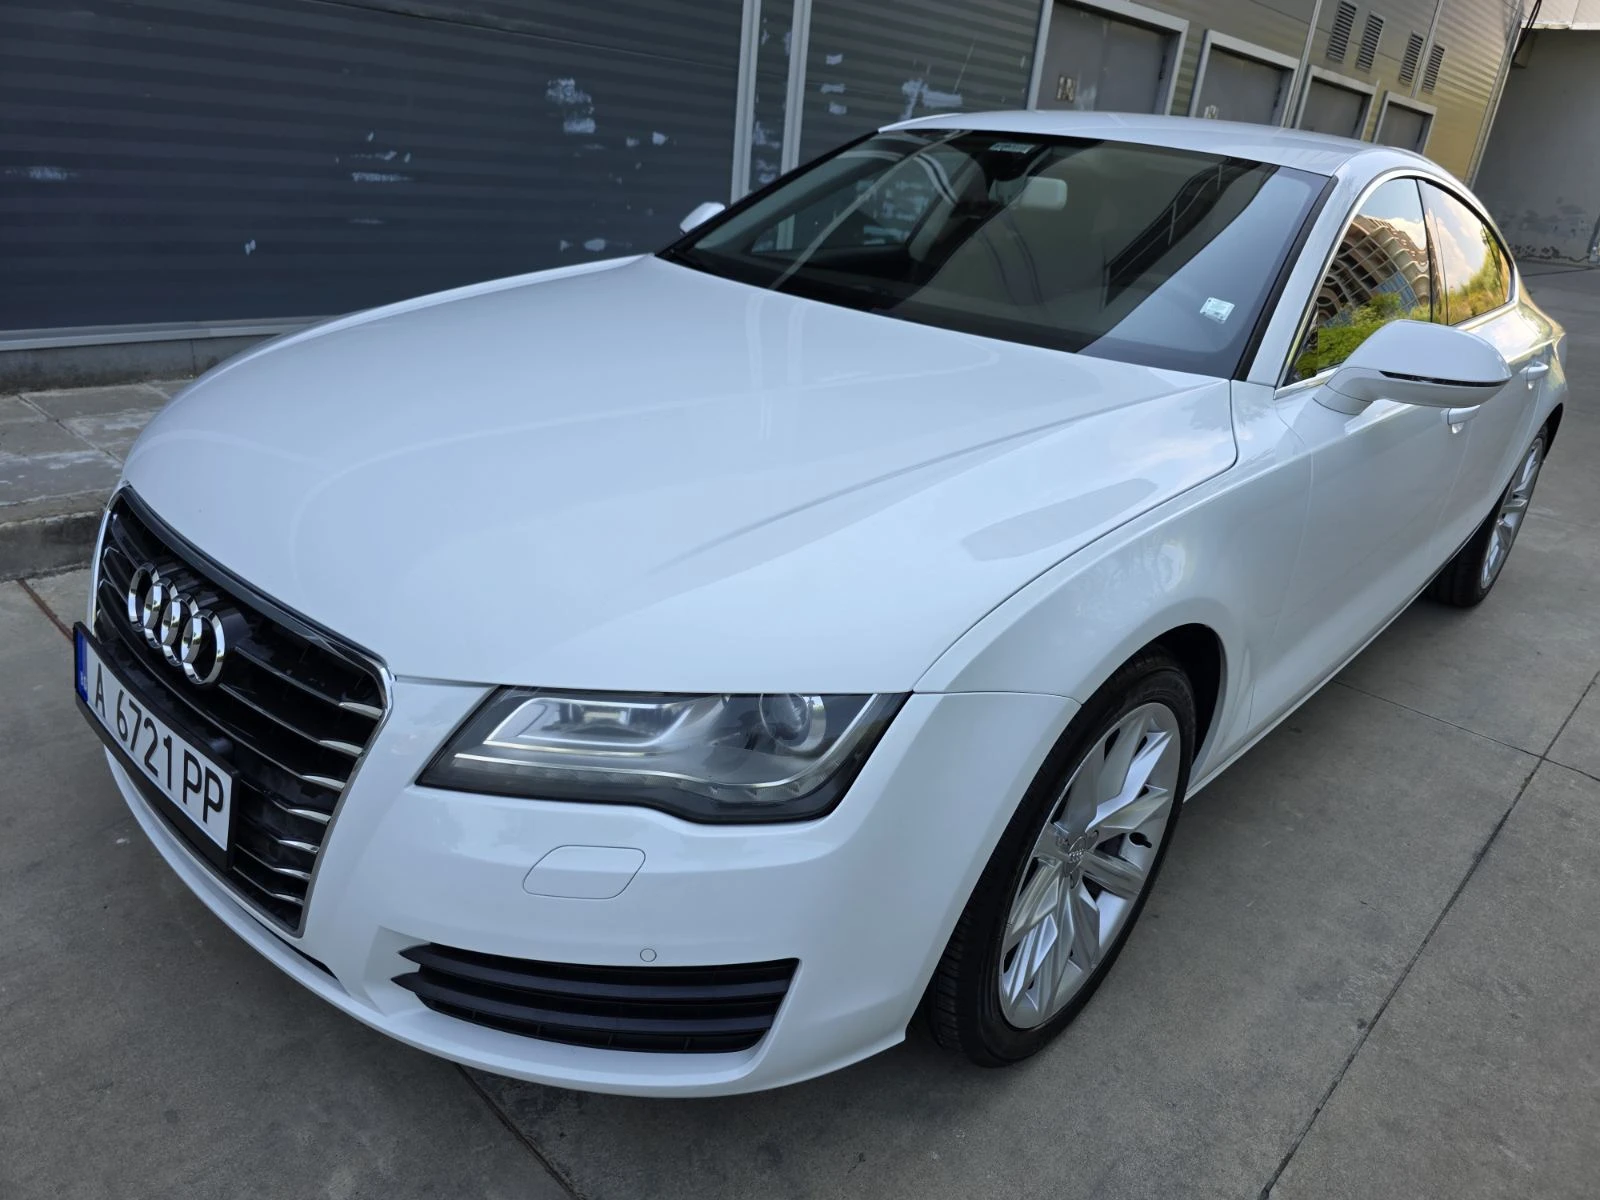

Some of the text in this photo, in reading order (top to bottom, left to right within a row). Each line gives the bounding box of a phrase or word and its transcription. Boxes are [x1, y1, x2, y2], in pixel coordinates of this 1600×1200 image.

[95, 662, 225, 825] A 6721 PP
